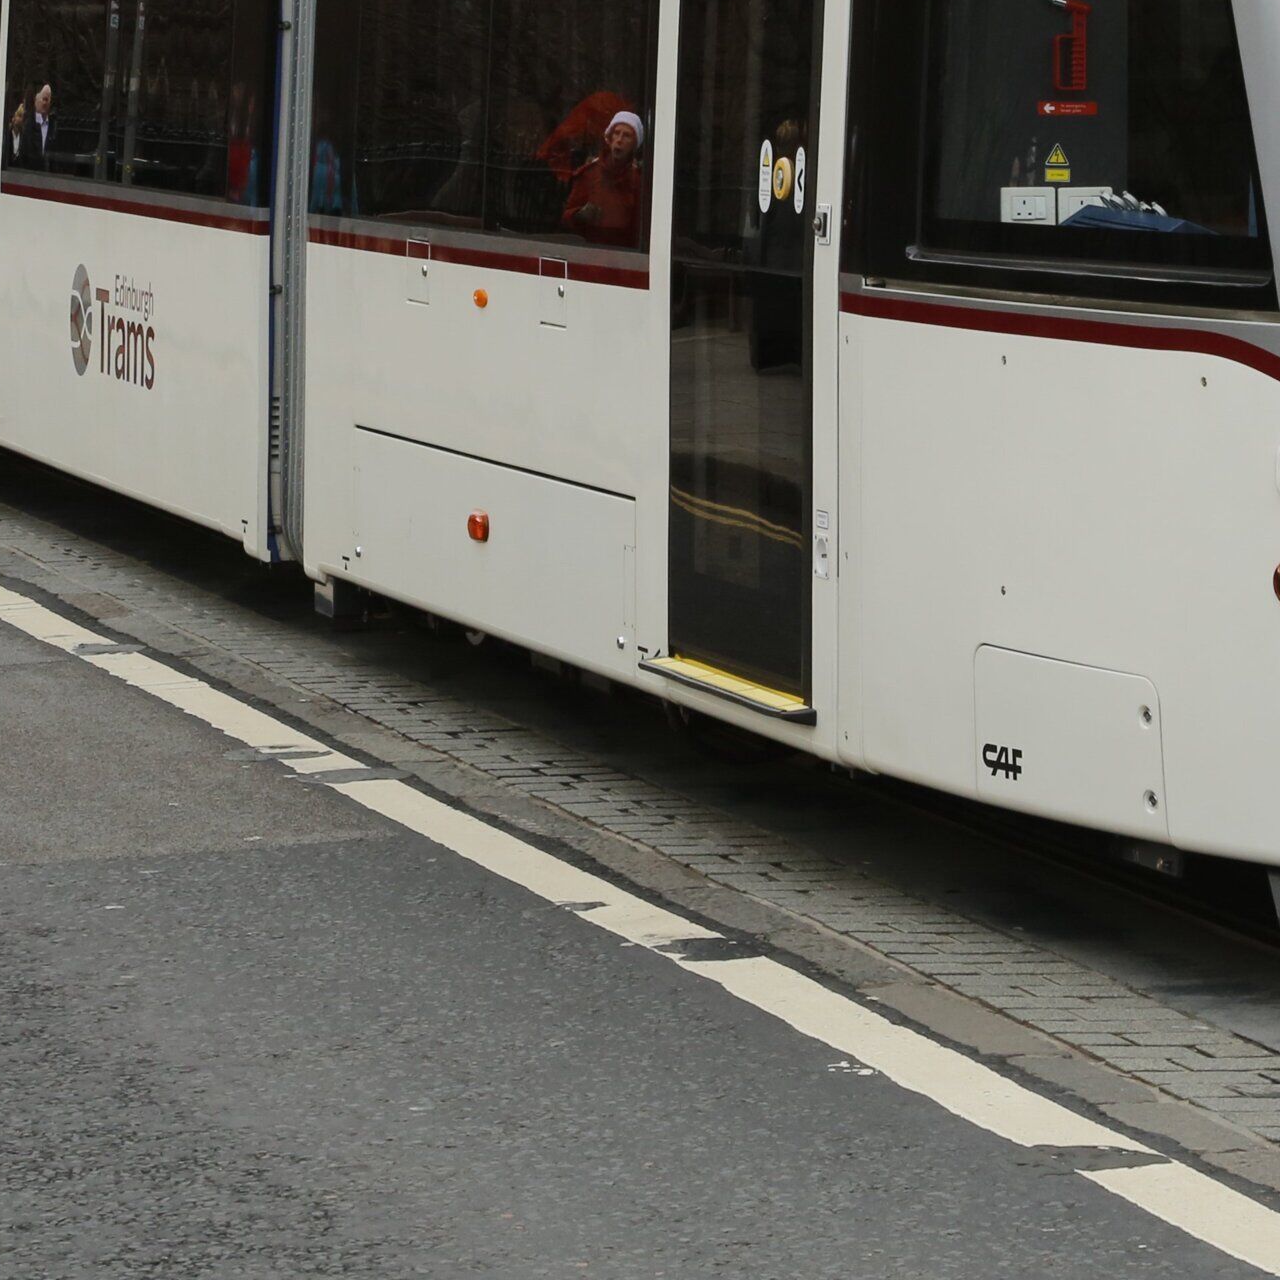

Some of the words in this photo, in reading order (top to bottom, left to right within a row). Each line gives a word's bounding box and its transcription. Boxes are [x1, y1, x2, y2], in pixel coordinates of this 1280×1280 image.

[114, 274, 154, 322] Edinburgh
[96, 287, 155, 390] Trams
[982, 743, 1022, 780] CAF
